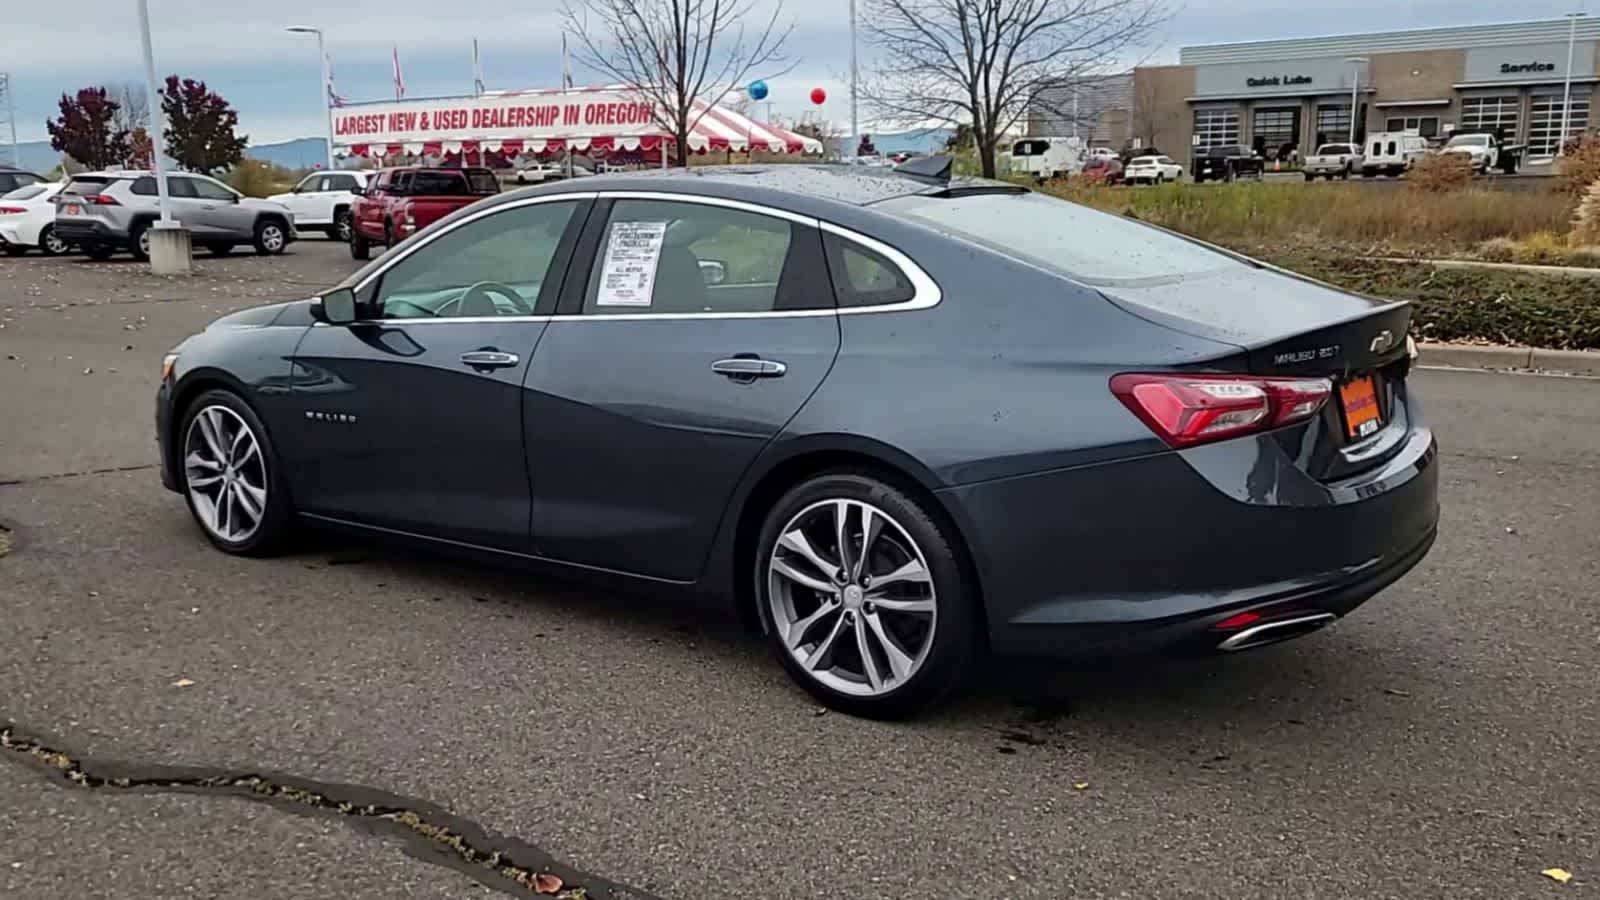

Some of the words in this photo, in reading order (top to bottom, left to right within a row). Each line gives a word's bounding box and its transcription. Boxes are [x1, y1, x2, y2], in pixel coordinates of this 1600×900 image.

[1500, 61, 1555, 73] Service
[335, 113, 385, 135] LARGEST
[388, 112, 417, 132] NEW
[420, 111, 430, 130] &
[433, 109, 468, 130] USED
[472, 105, 560, 128] DEALERSHIP
[563, 103, 580, 125] IN
